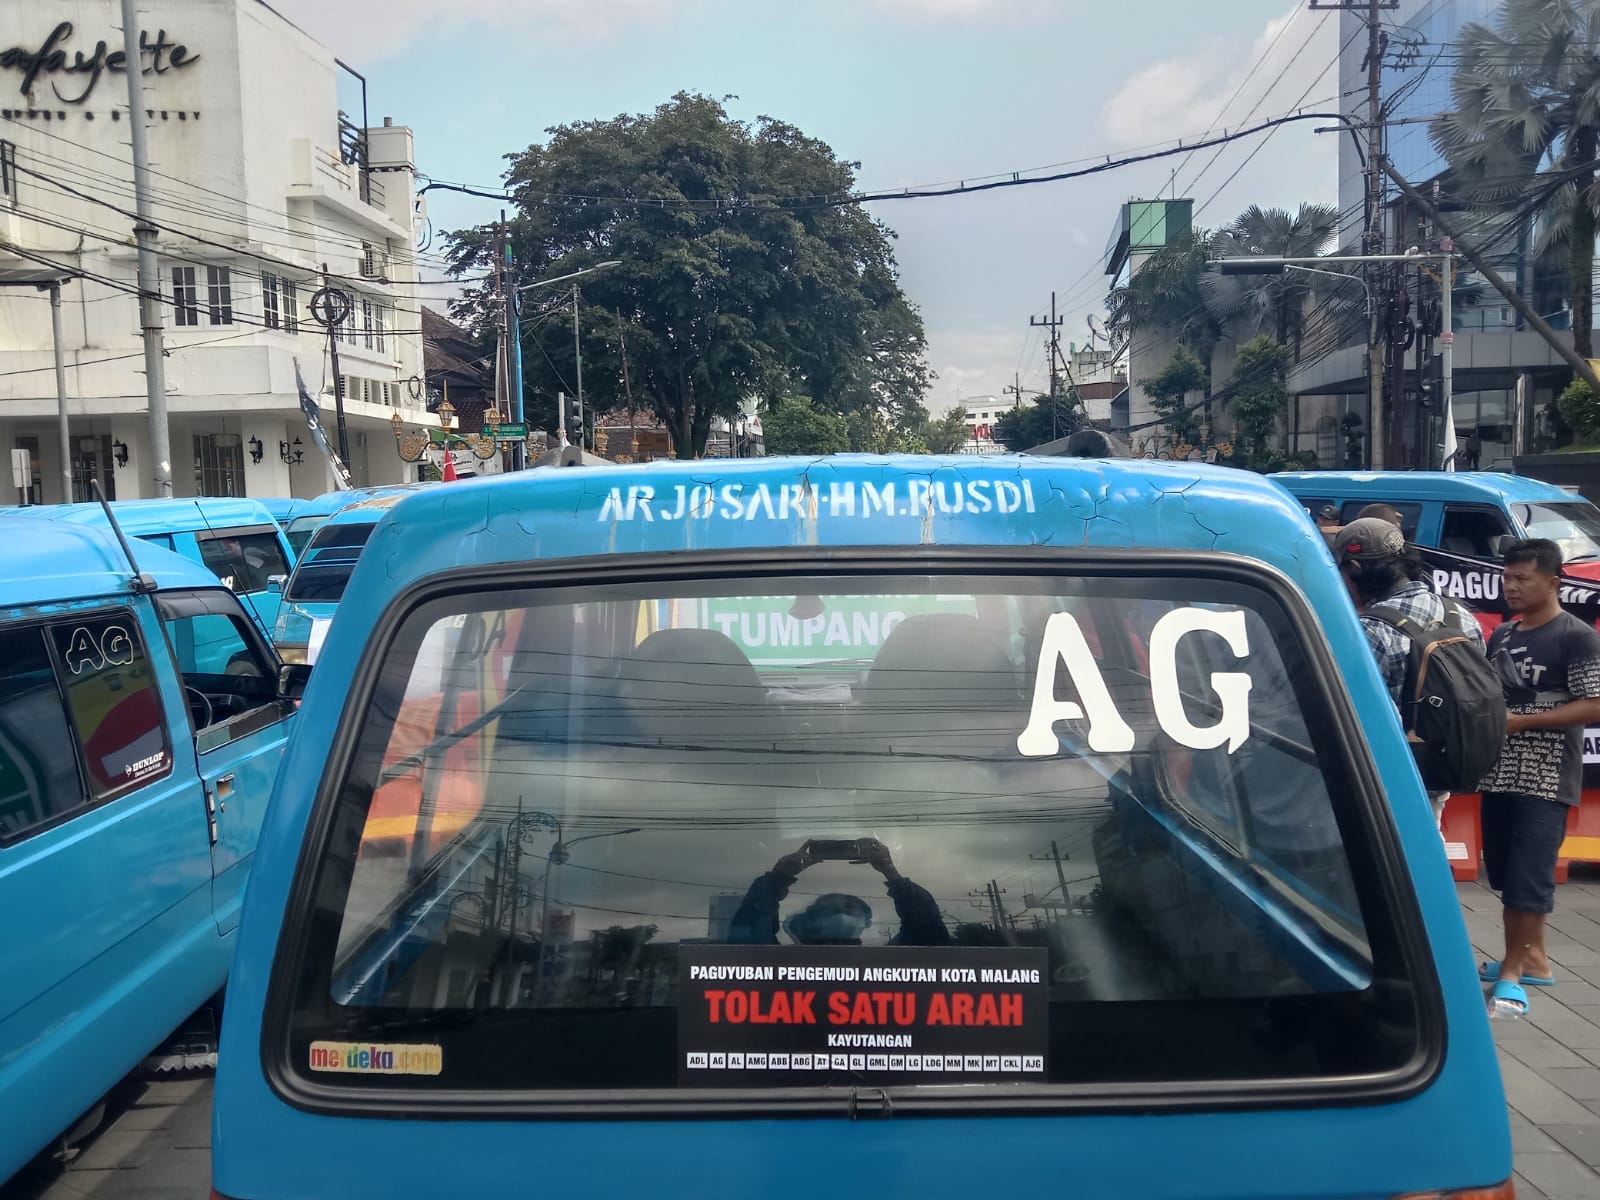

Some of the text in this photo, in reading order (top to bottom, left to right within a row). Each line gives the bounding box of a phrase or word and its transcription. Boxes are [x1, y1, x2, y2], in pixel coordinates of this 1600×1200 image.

[66, 626, 134, 675] AG
[1017, 607, 1253, 756] AG
[132, 752, 164, 772] DUNLOP
[690, 965, 1040, 984] PAGUYUBAN PENGEMUDI ANGKUTAN KOTA MALANG
[704, 989, 1024, 1027] TOLAK SATU ARAH
[828, 1033, 912, 1048] KAYUTANGAN
[311, 1046, 440, 1071] merdeka.com
[690, 1056, 1041, 1068] ADL AG AL AMG ABB ABG AT GA GL GML GM LG LDG MM MK MT CKL AJG
